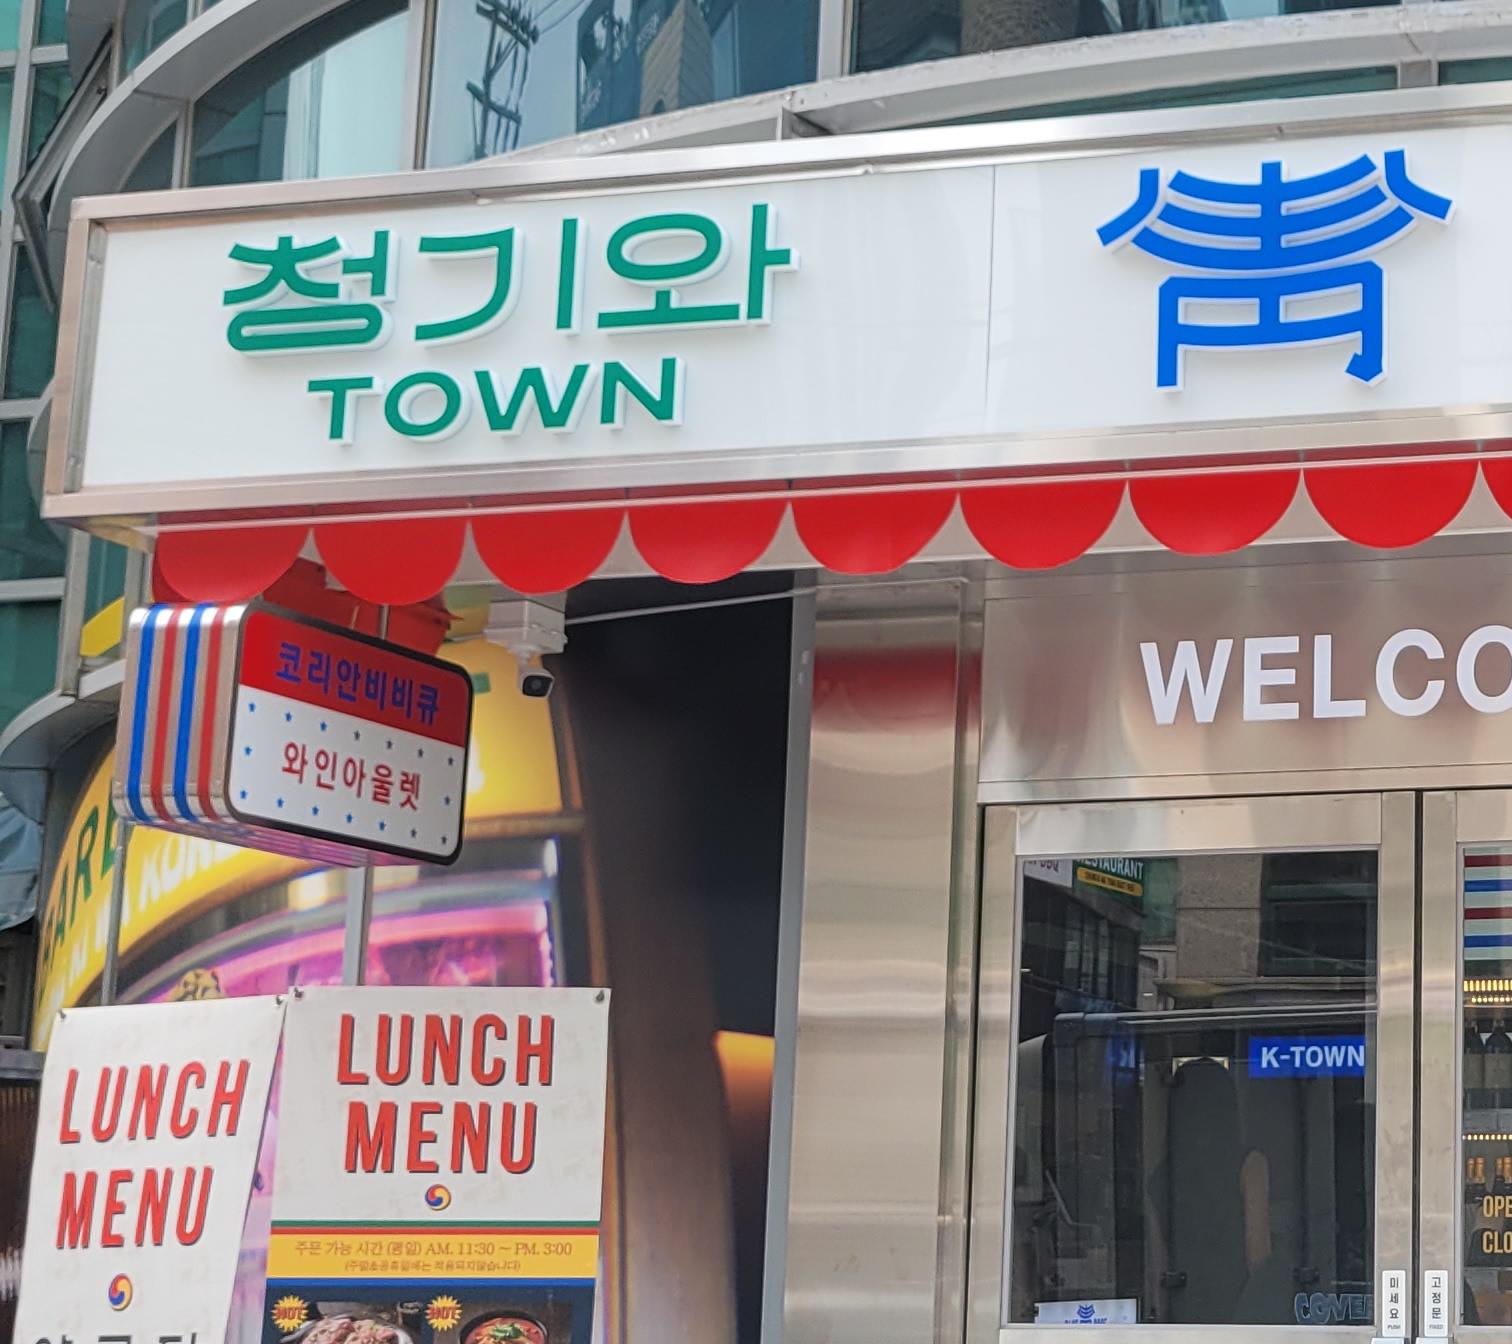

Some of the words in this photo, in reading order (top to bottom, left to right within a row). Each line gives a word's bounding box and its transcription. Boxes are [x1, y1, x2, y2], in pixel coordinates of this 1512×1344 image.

[222, 203, 790, 352] 청기와
[307, 357, 678, 440] TOWN
[275, 641, 440, 727] 코리안비비큐
[281, 741, 421, 812] 와인아울렛
[337, 1014, 555, 1086] LUNCH
[1260, 1044, 1365, 1069] K-TOWN
[59, 1059, 250, 1144] LUNCH
[344, 1102, 538, 1174] MENU
[55, 1166, 213, 1250] MENU
[295, 1241, 321, 1256] 주문
[327, 1241, 351, 1256] 가능
[358, 1241, 382, 1256] 시간
[386, 1240, 423, 1257] (평일)
[426, 1241, 453, 1255] AM.
[457, 1241, 495, 1255] 11:30
[515, 1241, 540, 1255] PM.
[543, 1241, 572, 1255] 3:00
[276, 1307, 302, 1320] HOT
[429, 1307, 458, 1320] HOT
[1389, 1277, 1400, 1319] 미세요
[1432, 1277, 1442, 1319] 고정문
